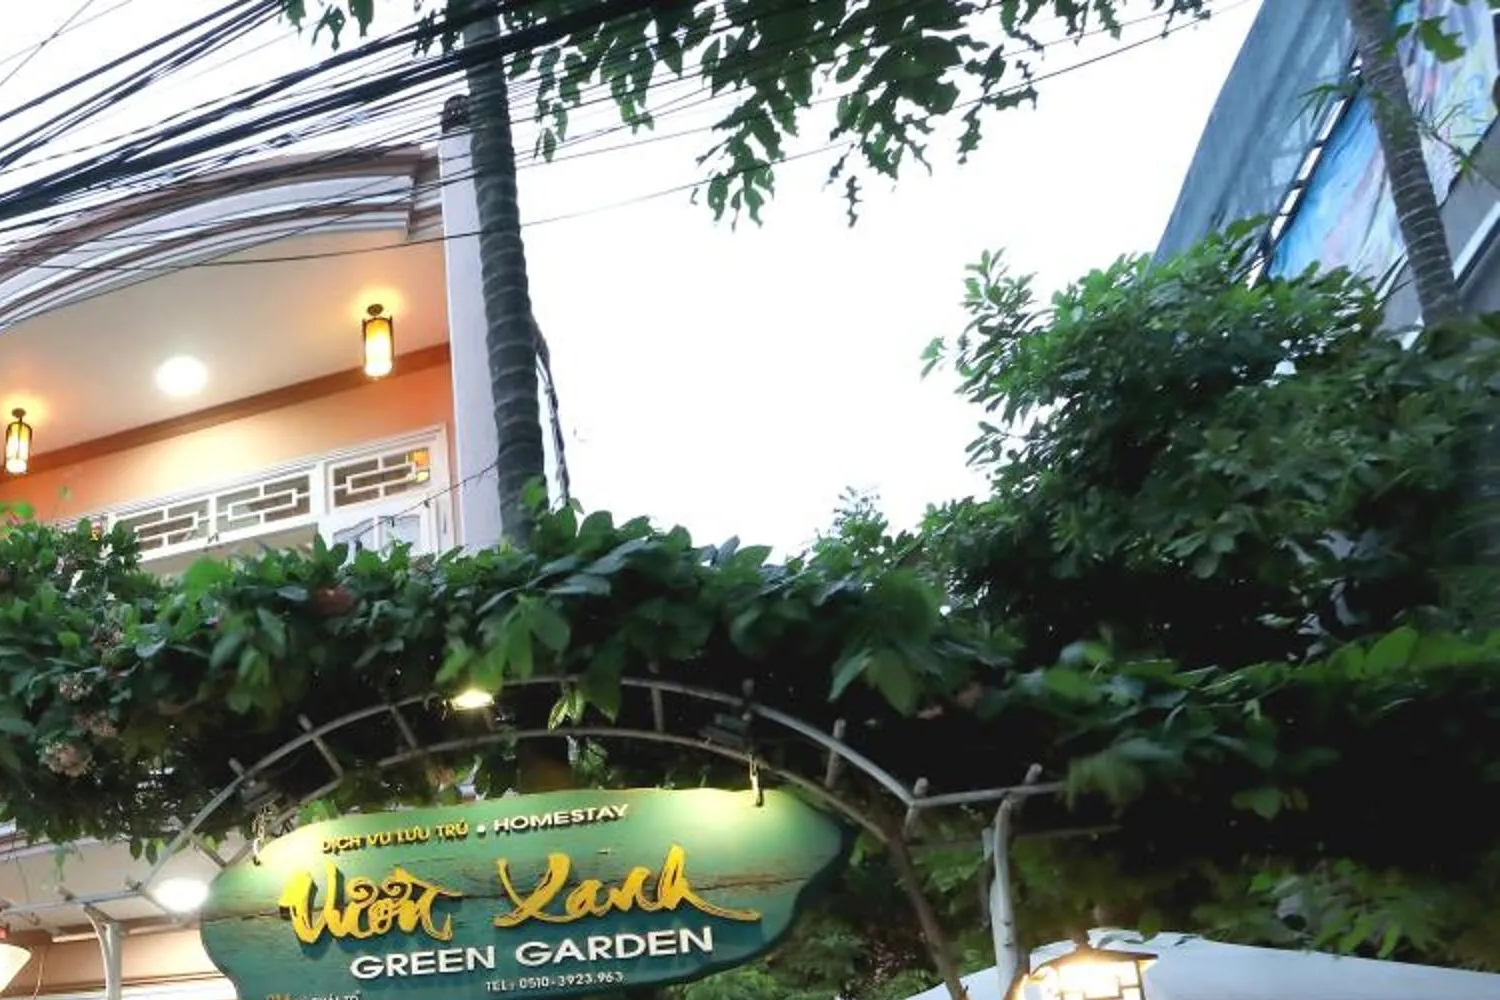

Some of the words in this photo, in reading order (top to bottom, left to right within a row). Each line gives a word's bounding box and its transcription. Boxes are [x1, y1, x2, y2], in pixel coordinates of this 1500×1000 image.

[494, 804, 629, 833] HOMESTAY
[350, 945, 495, 979] GREEN
[515, 926, 713, 967] GARDEN
